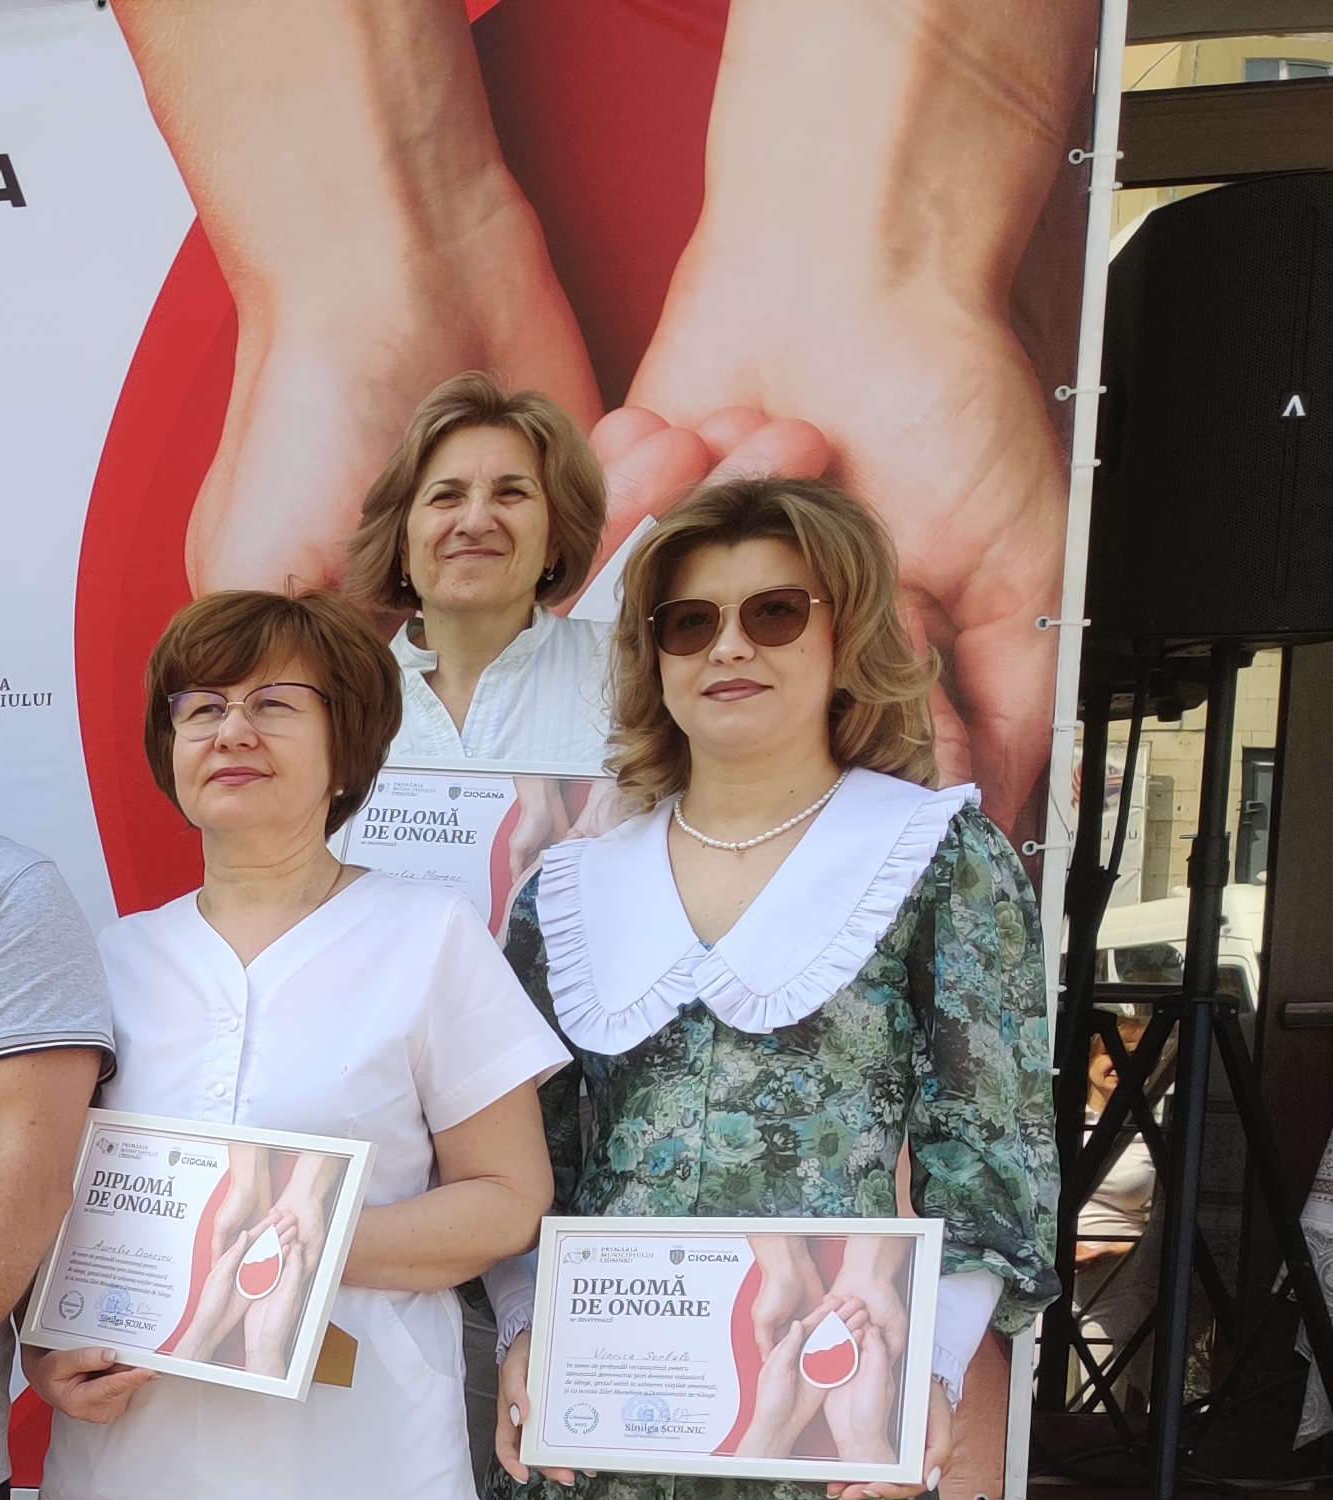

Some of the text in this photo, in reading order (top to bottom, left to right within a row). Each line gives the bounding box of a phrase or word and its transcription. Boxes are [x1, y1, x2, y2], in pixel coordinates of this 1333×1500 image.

[365, 807, 459, 827] DIPLOMĂ
[362, 824, 477, 845] DE ONOARE
[91, 1170, 175, 1198] DIPLOMĂ
[85, 1189, 188, 1220] DE ONOARE
[687, 1254, 740, 1263] CIOCANA
[572, 1274, 687, 1296] DIPLOMĂ
[570, 1298, 711, 1317] DE ONOARE
